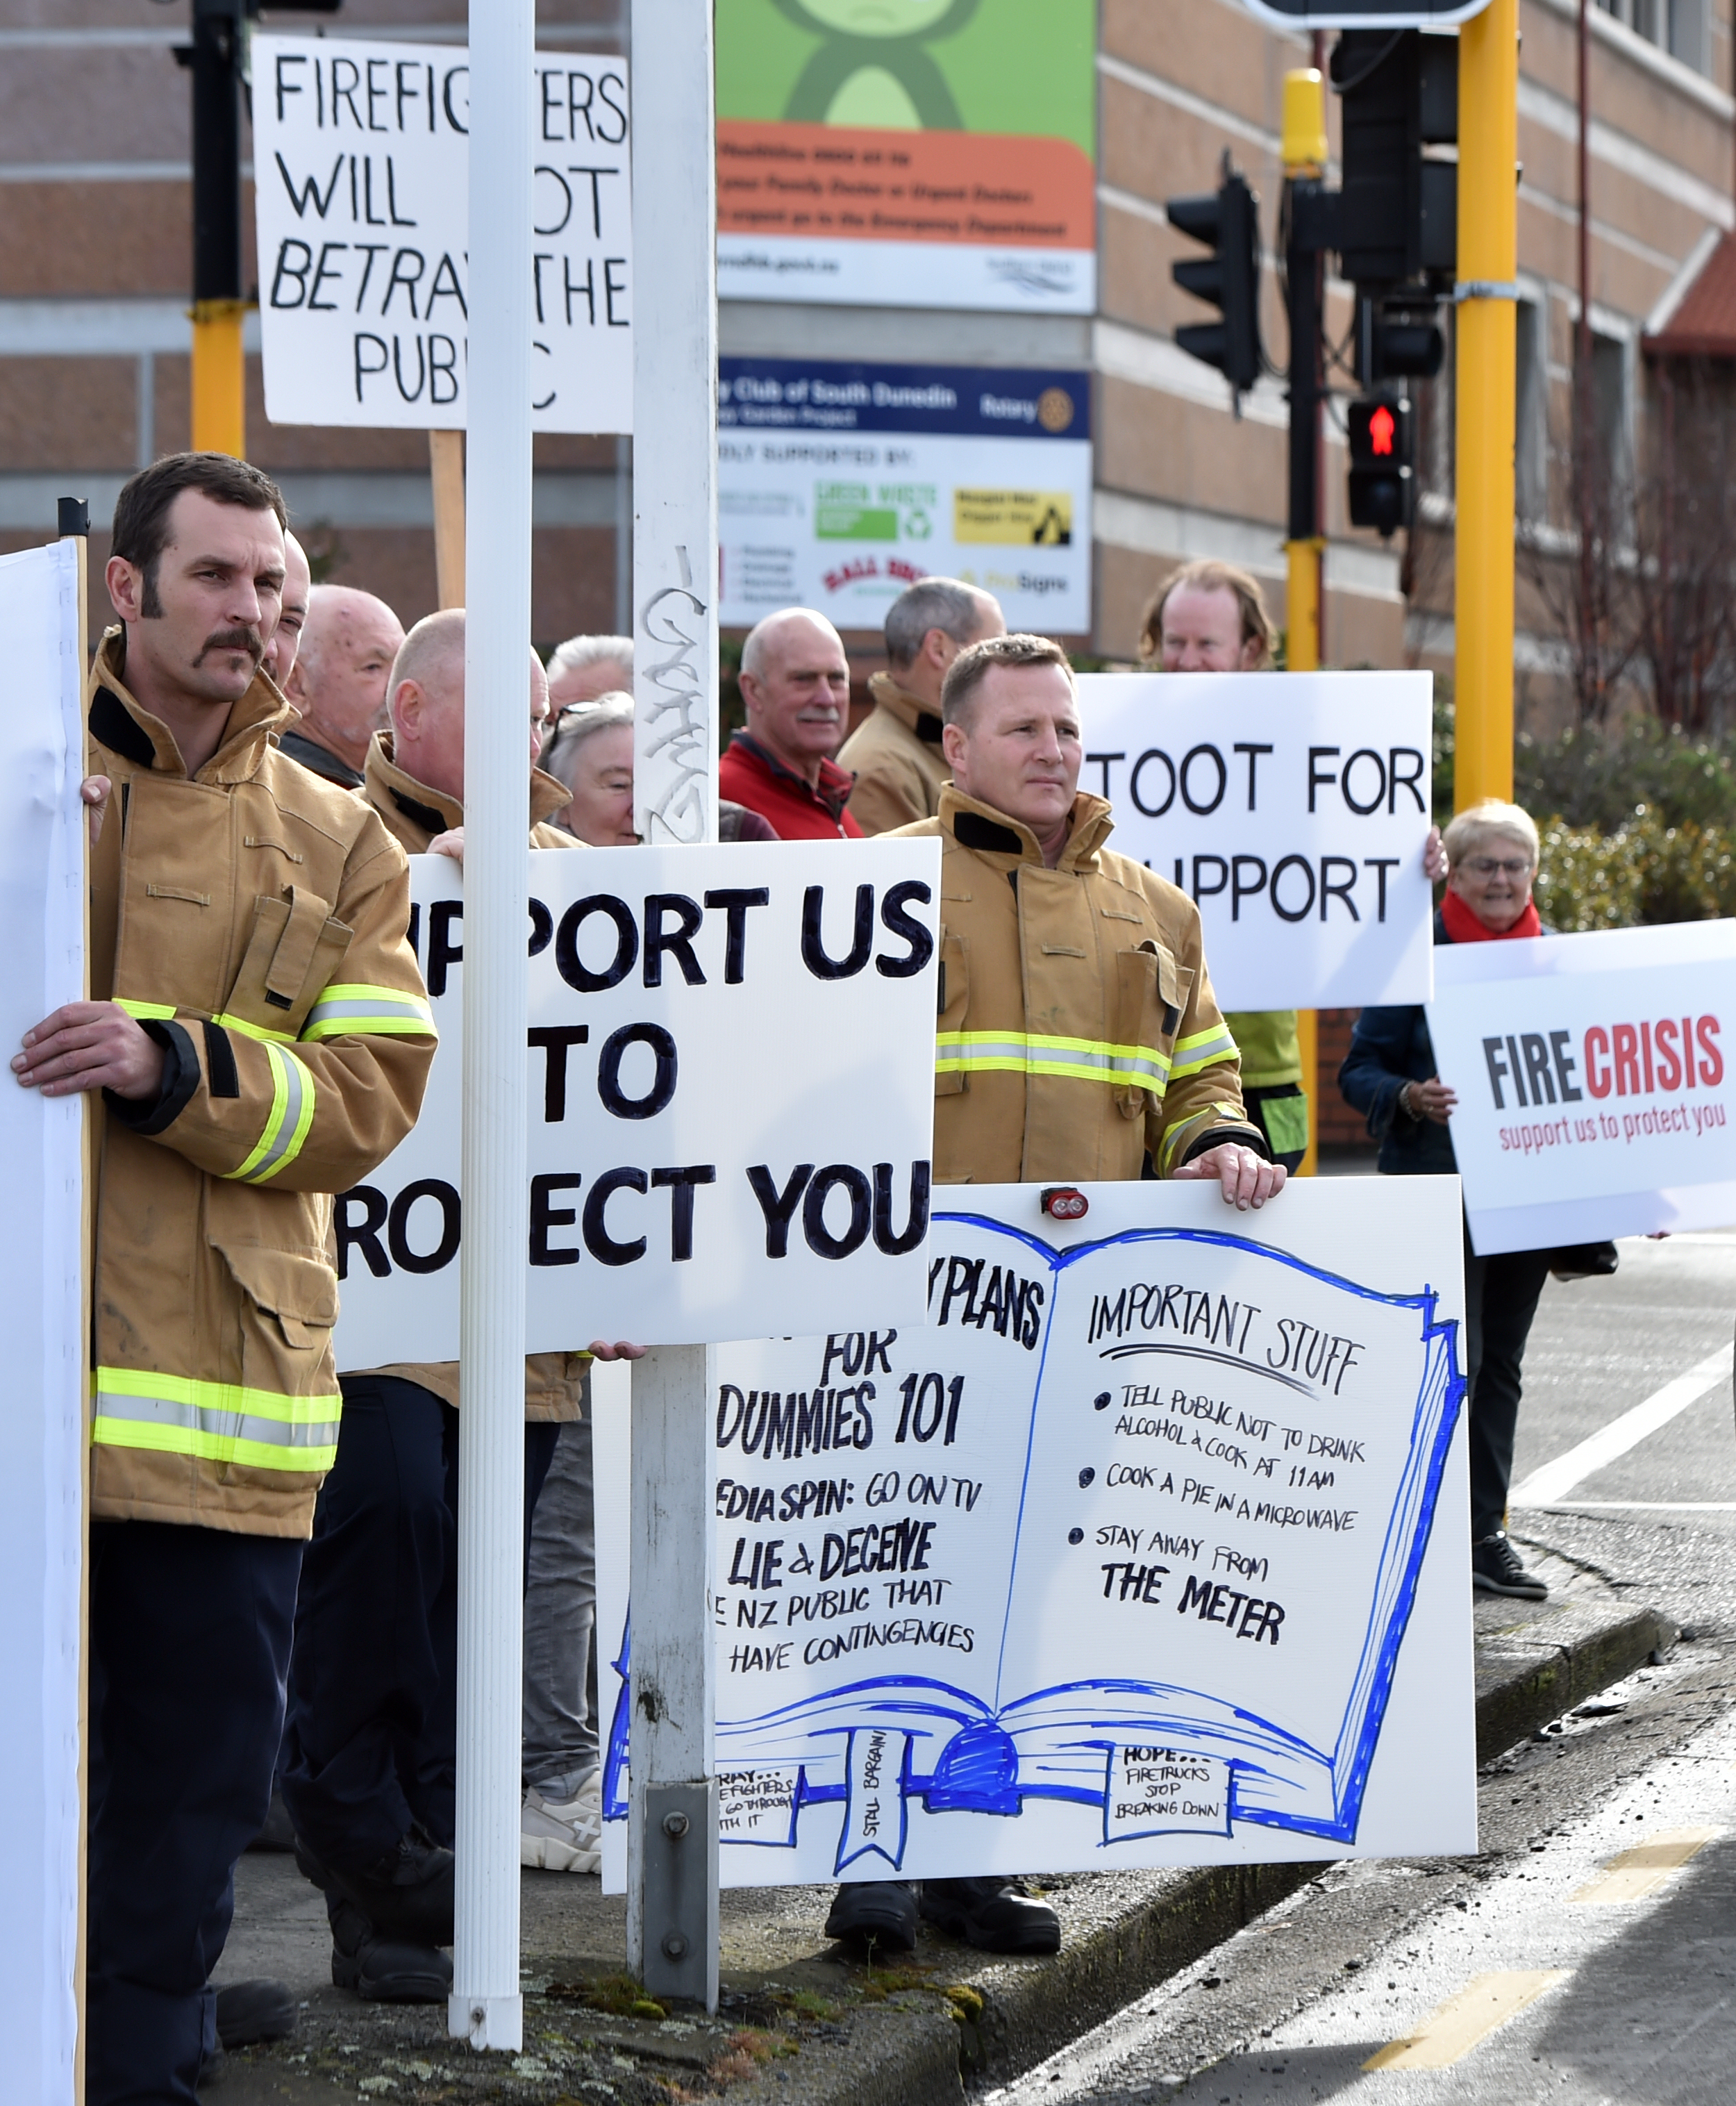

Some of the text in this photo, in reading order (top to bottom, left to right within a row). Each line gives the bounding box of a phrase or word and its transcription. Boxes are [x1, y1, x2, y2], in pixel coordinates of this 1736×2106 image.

[275, 150, 619, 238] WILL OT
[270, 238, 468, 321] BETRA
[734, 376, 783, 404] Club
[784, 377, 809, 404] of
[810, 379, 871, 406] South
[872, 381, 958, 409] Dunedin
[980, 393, 1039, 424] Rotary
[762, 442, 880, 466] SUPPORTED
[1085, 743, 1426, 818] TOOT FOR
[801, 881, 933, 980] US
[528, 1022, 678, 1122] TO
[1499, 1103, 1726, 1155] support us to protect you
[333, 1161, 930, 1279] ROECT YOU
[937, 1255, 1044, 1351] PLANS
[819, 1329, 897, 1388] FOR
[1088, 1283, 1365, 1395] IMPORTANT STUFF
[717, 1373, 965, 1459] DUMMIES 101
[1115, 1414, 1187, 1445] ALCOHOL
[1205, 1436, 1248, 1468] COOK
[1253, 1457, 1281, 1479] AT
[1121, 1386, 1365, 1462] TELL PUBLIC NOT TO DRINK
[716, 1479, 775, 1523] EDIA
[865, 1471, 901, 1507] GO
[908, 1473, 948, 1506] ON
[951, 1477, 983, 1512] TV
[1107, 1462, 1359, 1531] COOK A PIE IN A MICROWAVE
[727, 1537, 785, 1591] LIE
[819, 1517, 937, 1582] DECEIVE
[1095, 1525, 1269, 1582] STAY AWAY FROM
[737, 1599, 778, 1629] NZ
[787, 1587, 870, 1627] PUBLIC
[883, 1578, 952, 1609] THAT
[1101, 1563, 1285, 1645] THE METER
[728, 1641, 794, 1673] HAVE
[715, 1770, 781, 1786] RAY...
[1115, 1800, 1219, 1819] BREAKING DOWN
[1145, 1782, 1181, 1798] STOP
[719, 1814, 763, 1830] ITH IT
